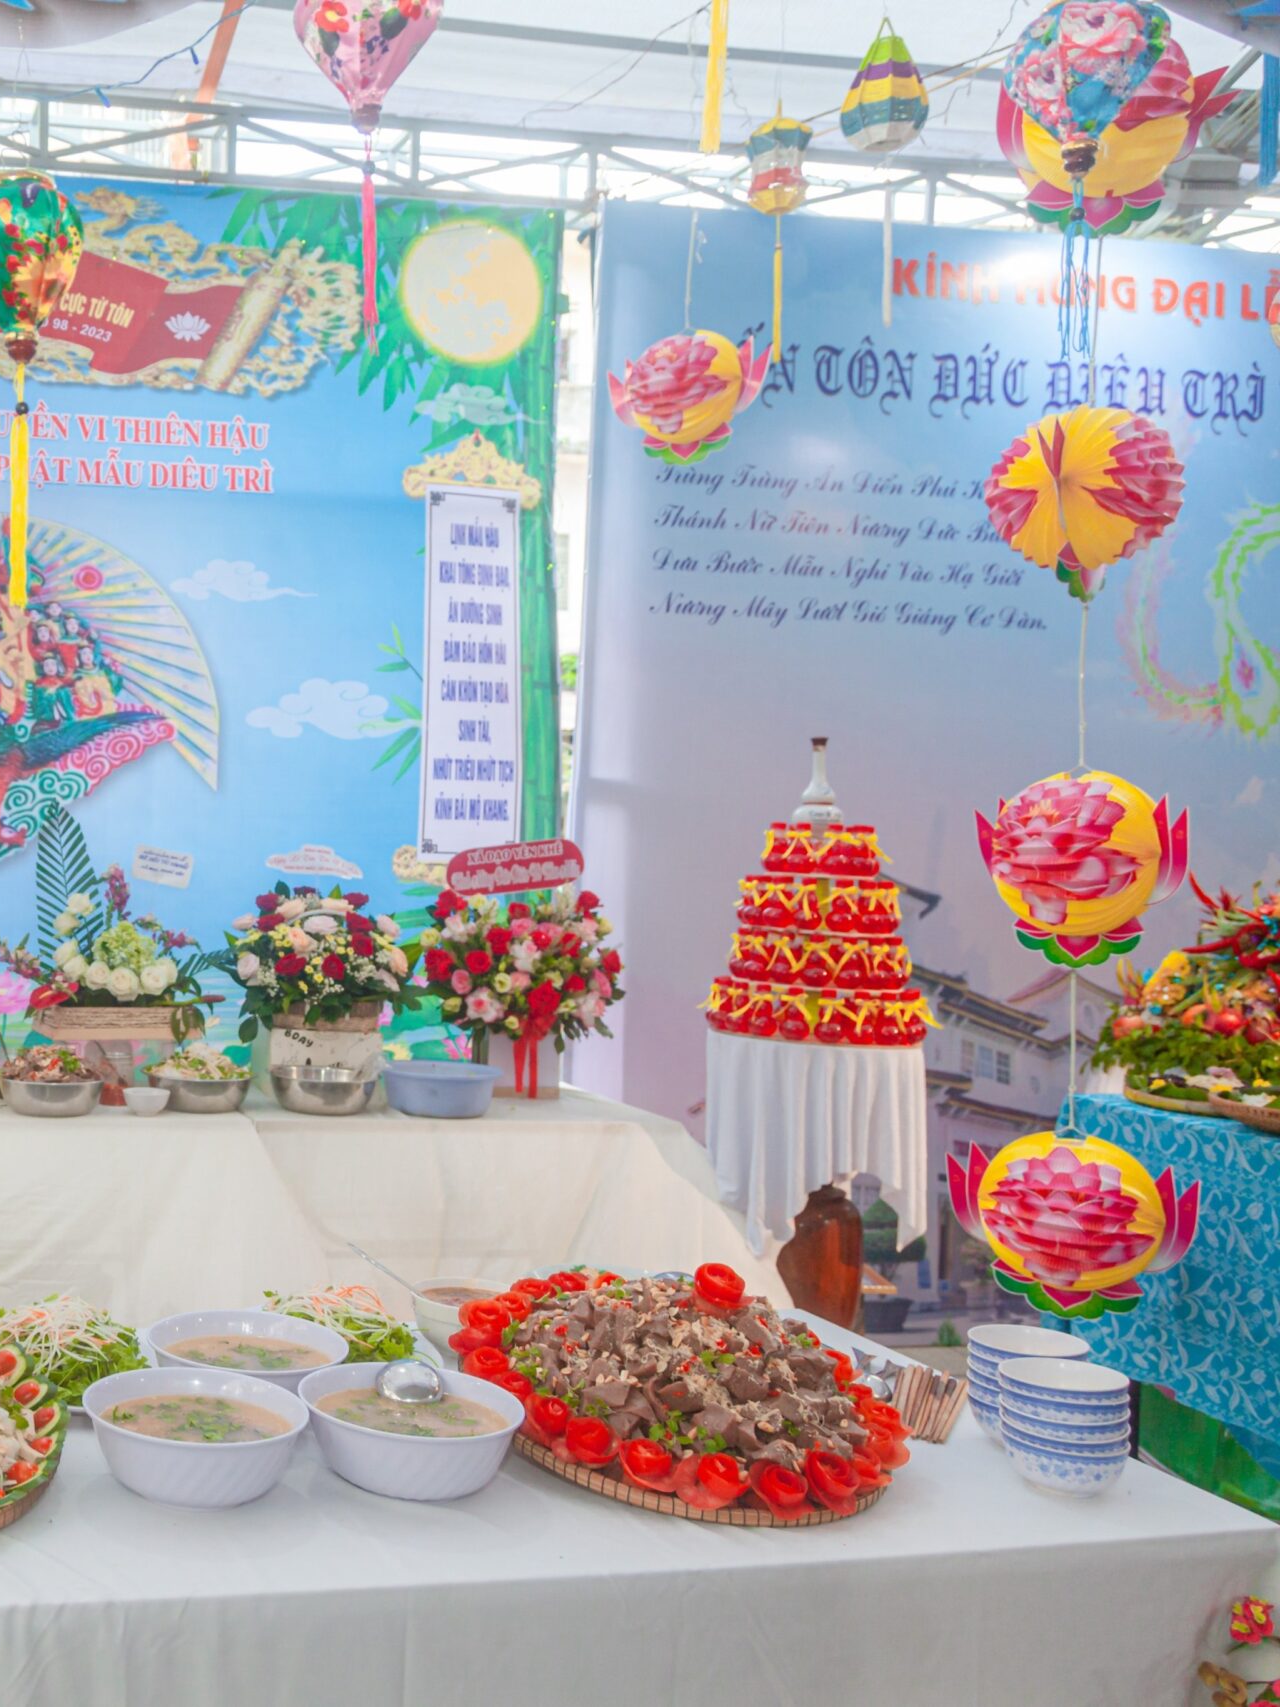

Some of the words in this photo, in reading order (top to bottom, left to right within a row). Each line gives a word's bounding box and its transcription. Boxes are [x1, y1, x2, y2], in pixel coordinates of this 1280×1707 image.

[1152, 278, 1225, 326] ĐẠI
[80, 323, 113, 343] 2023
[813, 336, 918, 415] TÔN
[1181, 361, 1267, 437] TRÌ
[76, 414, 107, 442] VI
[113, 412, 201, 447] THIÊN
[206, 416, 270, 455] HẬU
[77, 447, 143, 487] MẪU
[149, 456, 218, 491] DIÊU
[224, 460, 275, 494] TRÌ
[654, 503, 727, 531] Thánh
[837, 512, 911, 549] Nương
[830, 556, 888, 588] Nghi
[649, 591, 726, 626] Nương
[732, 596, 788, 629] Mây
[894, 601, 958, 636] Giáng
